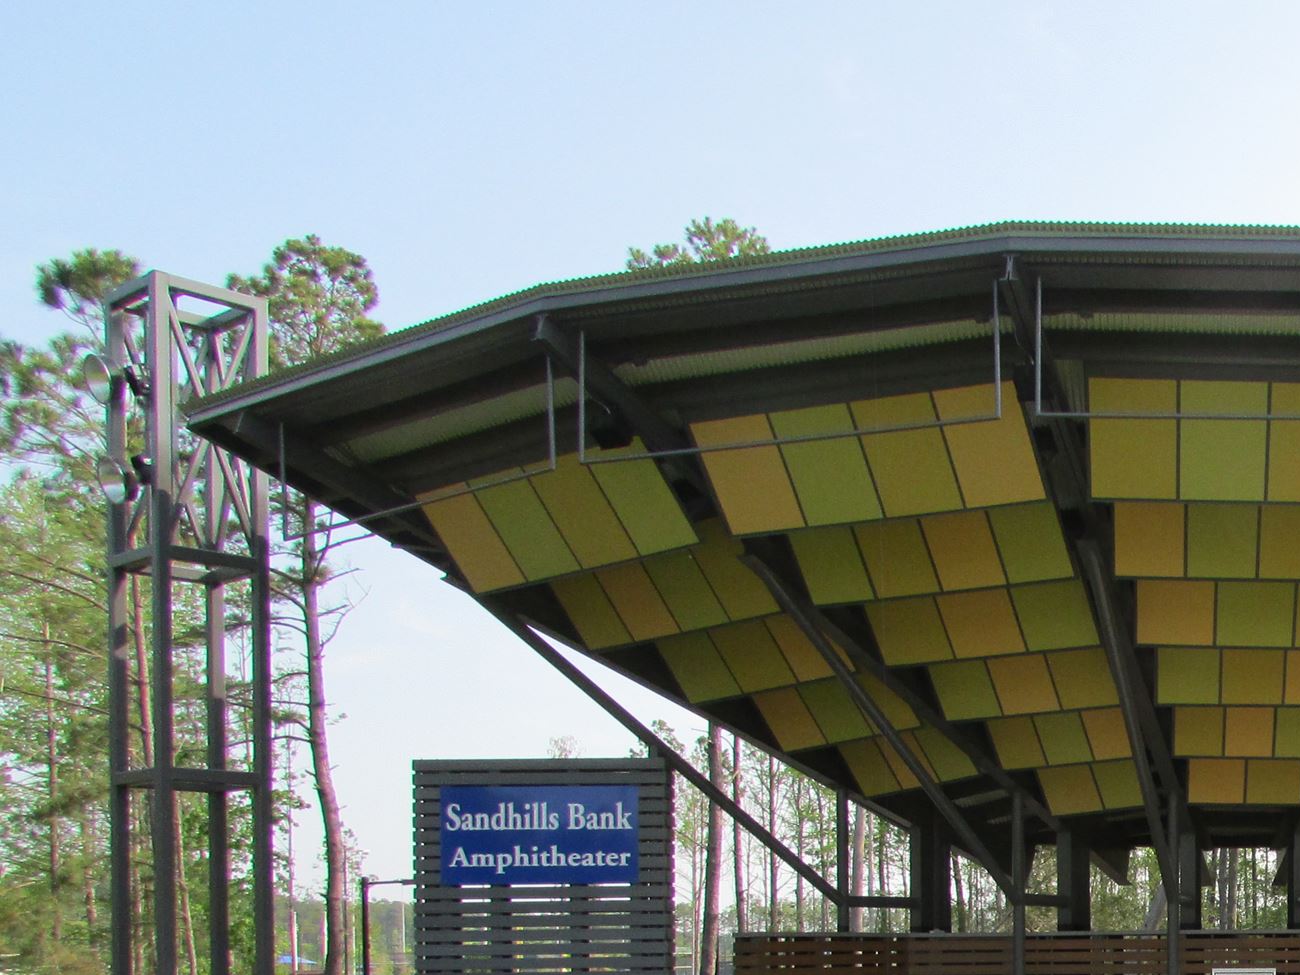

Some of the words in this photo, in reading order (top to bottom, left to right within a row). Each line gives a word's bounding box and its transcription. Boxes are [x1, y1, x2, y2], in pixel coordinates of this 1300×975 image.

[446, 801, 559, 831] Sandhills
[567, 801, 633, 830] Bank
[449, 845, 632, 874] Amphitheater
